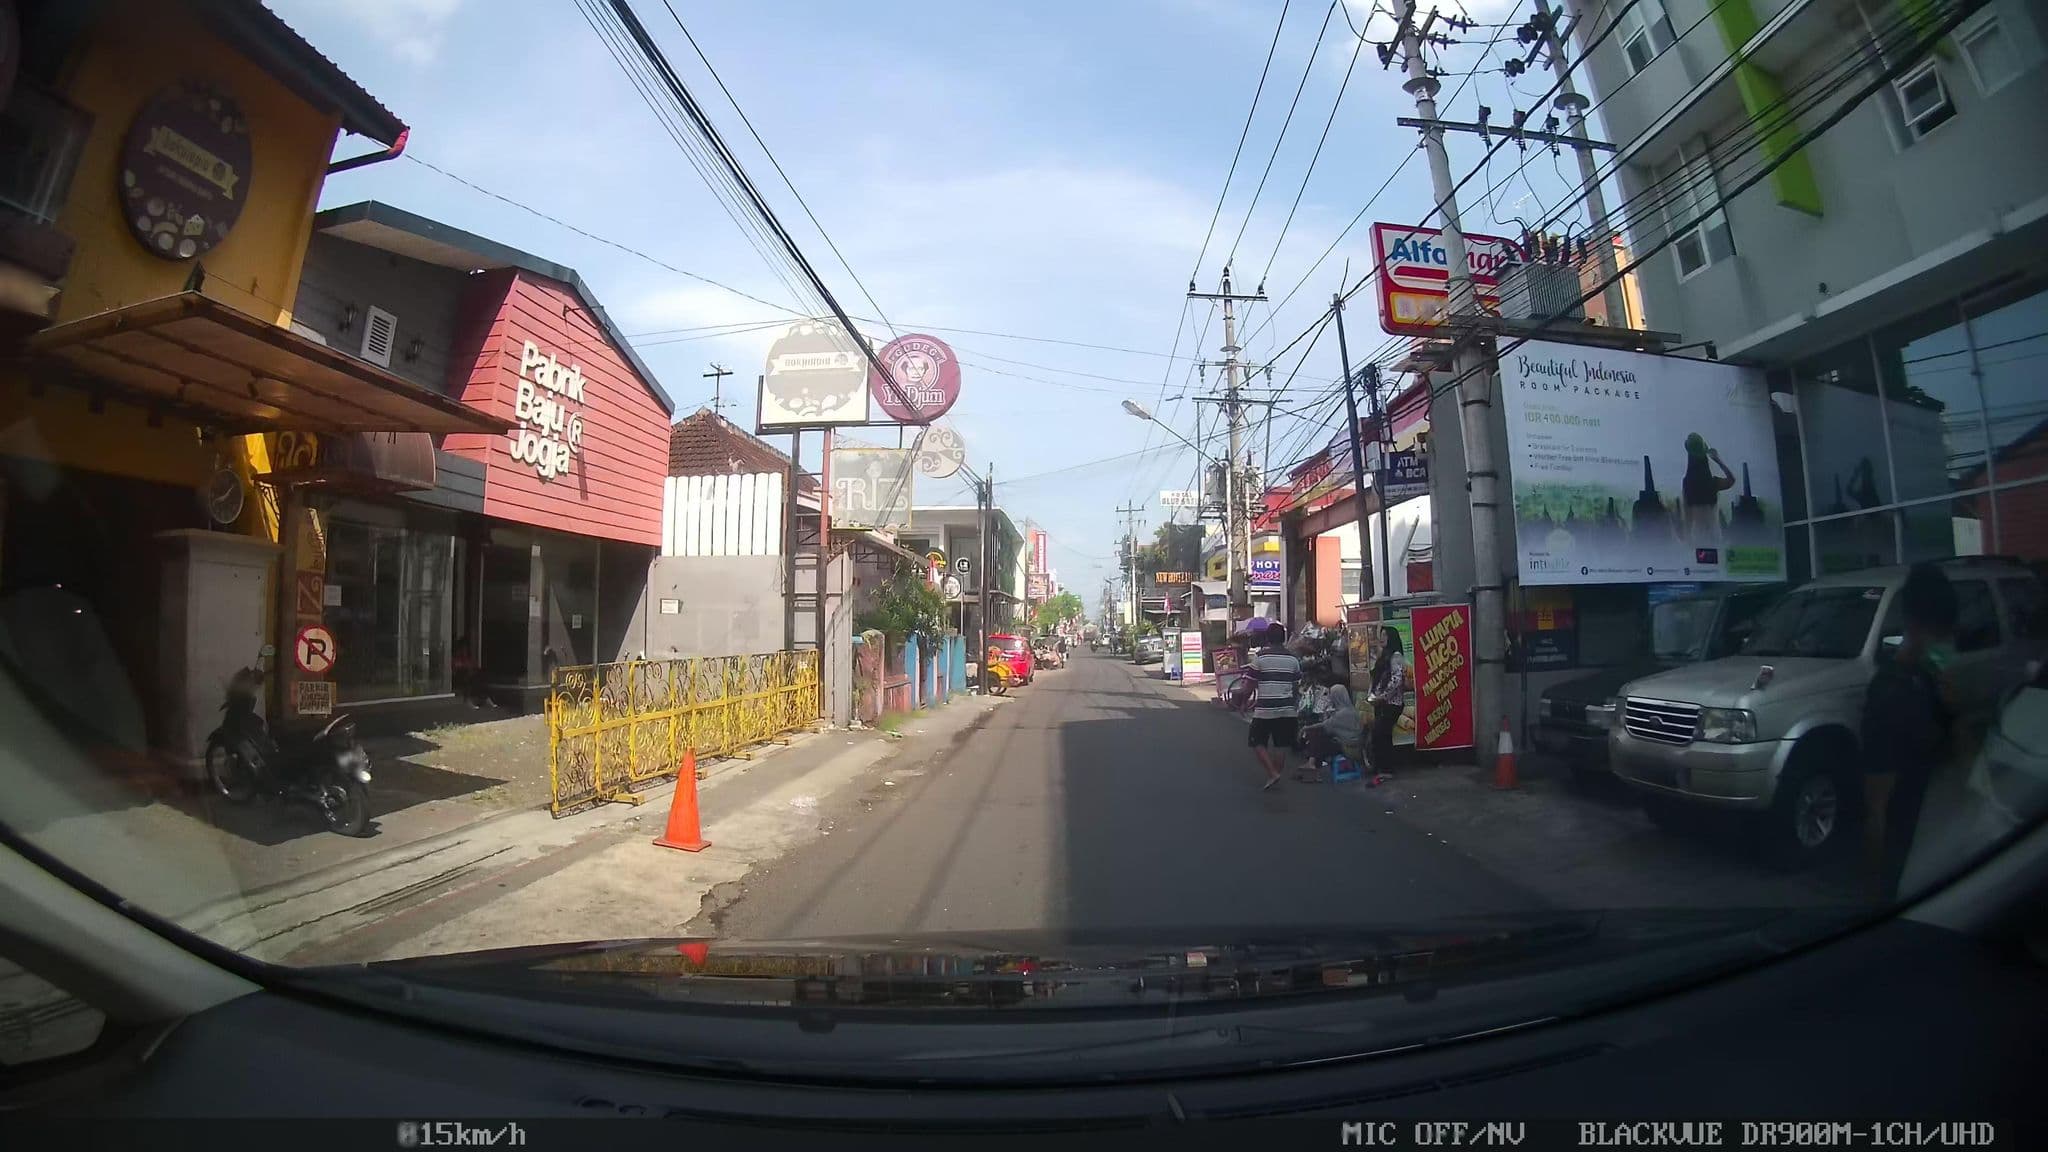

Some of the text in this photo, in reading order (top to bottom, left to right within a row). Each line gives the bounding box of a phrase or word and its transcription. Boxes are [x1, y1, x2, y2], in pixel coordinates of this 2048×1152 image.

[895, 342, 938, 357] GUDEG
[520, 340, 587, 402] Pabrik
[1518, 355, 1637, 387] Beautiful Indonesia
[1520, 381, 1641, 400] ROOM PACKAGE
[515, 378, 566, 436] Baju
[1397, 456, 1419, 468] ATM
[1405, 467, 1426, 479] BCA
[1419, 609, 1464, 652] LUMPIA
[1425, 635, 1459, 674] JAGO
